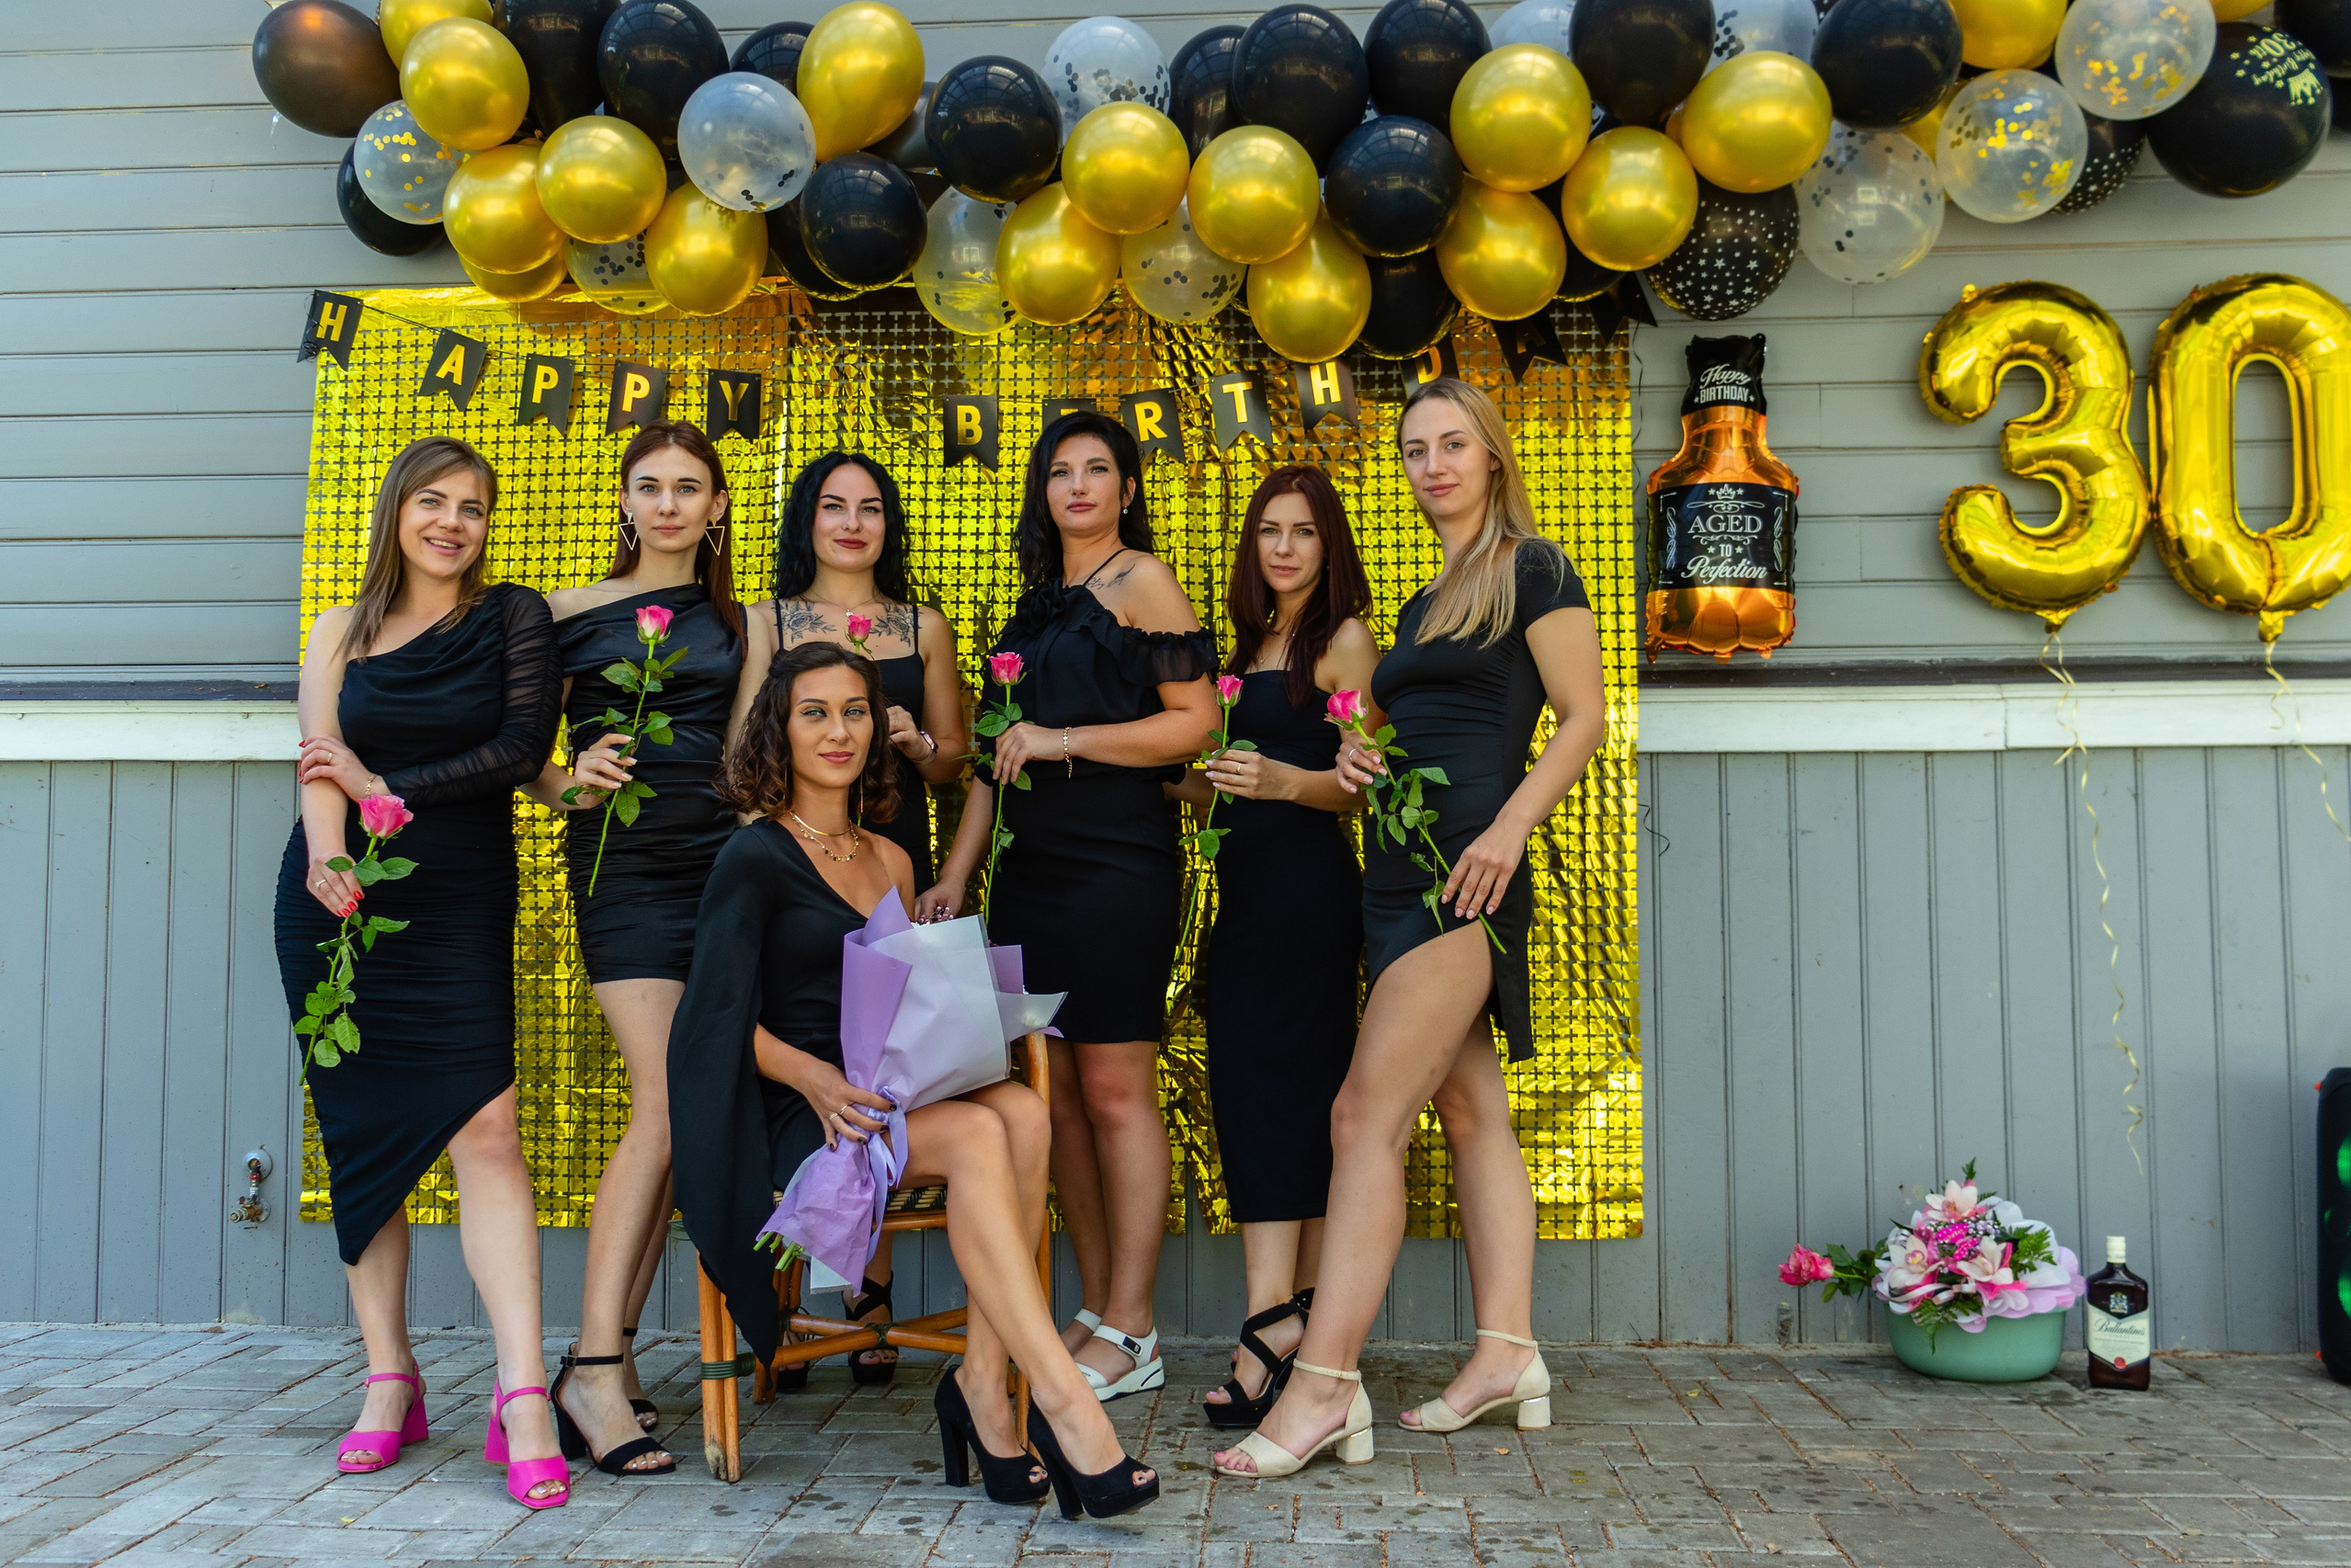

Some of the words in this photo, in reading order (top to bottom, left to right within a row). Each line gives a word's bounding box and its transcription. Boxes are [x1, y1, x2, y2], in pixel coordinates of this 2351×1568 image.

[2249, 33, 2296, 59] 30th
[2252, 57, 2298, 85] Birthday
[316, 301, 749, 421] HAPPY
[957, 283, 1626, 446] BRTHDA
[1699, 363, 1752, 390] Happy
[1699, 385, 1749, 403] BIRTHDAY
[1918, 272, 2351, 618] 30
[1687, 515, 1763, 534] AGED
[1719, 544, 1732, 557] TO
[1680, 555, 1768, 585] Perfection
[2093, 1318, 2146, 1336] Ballantine's
